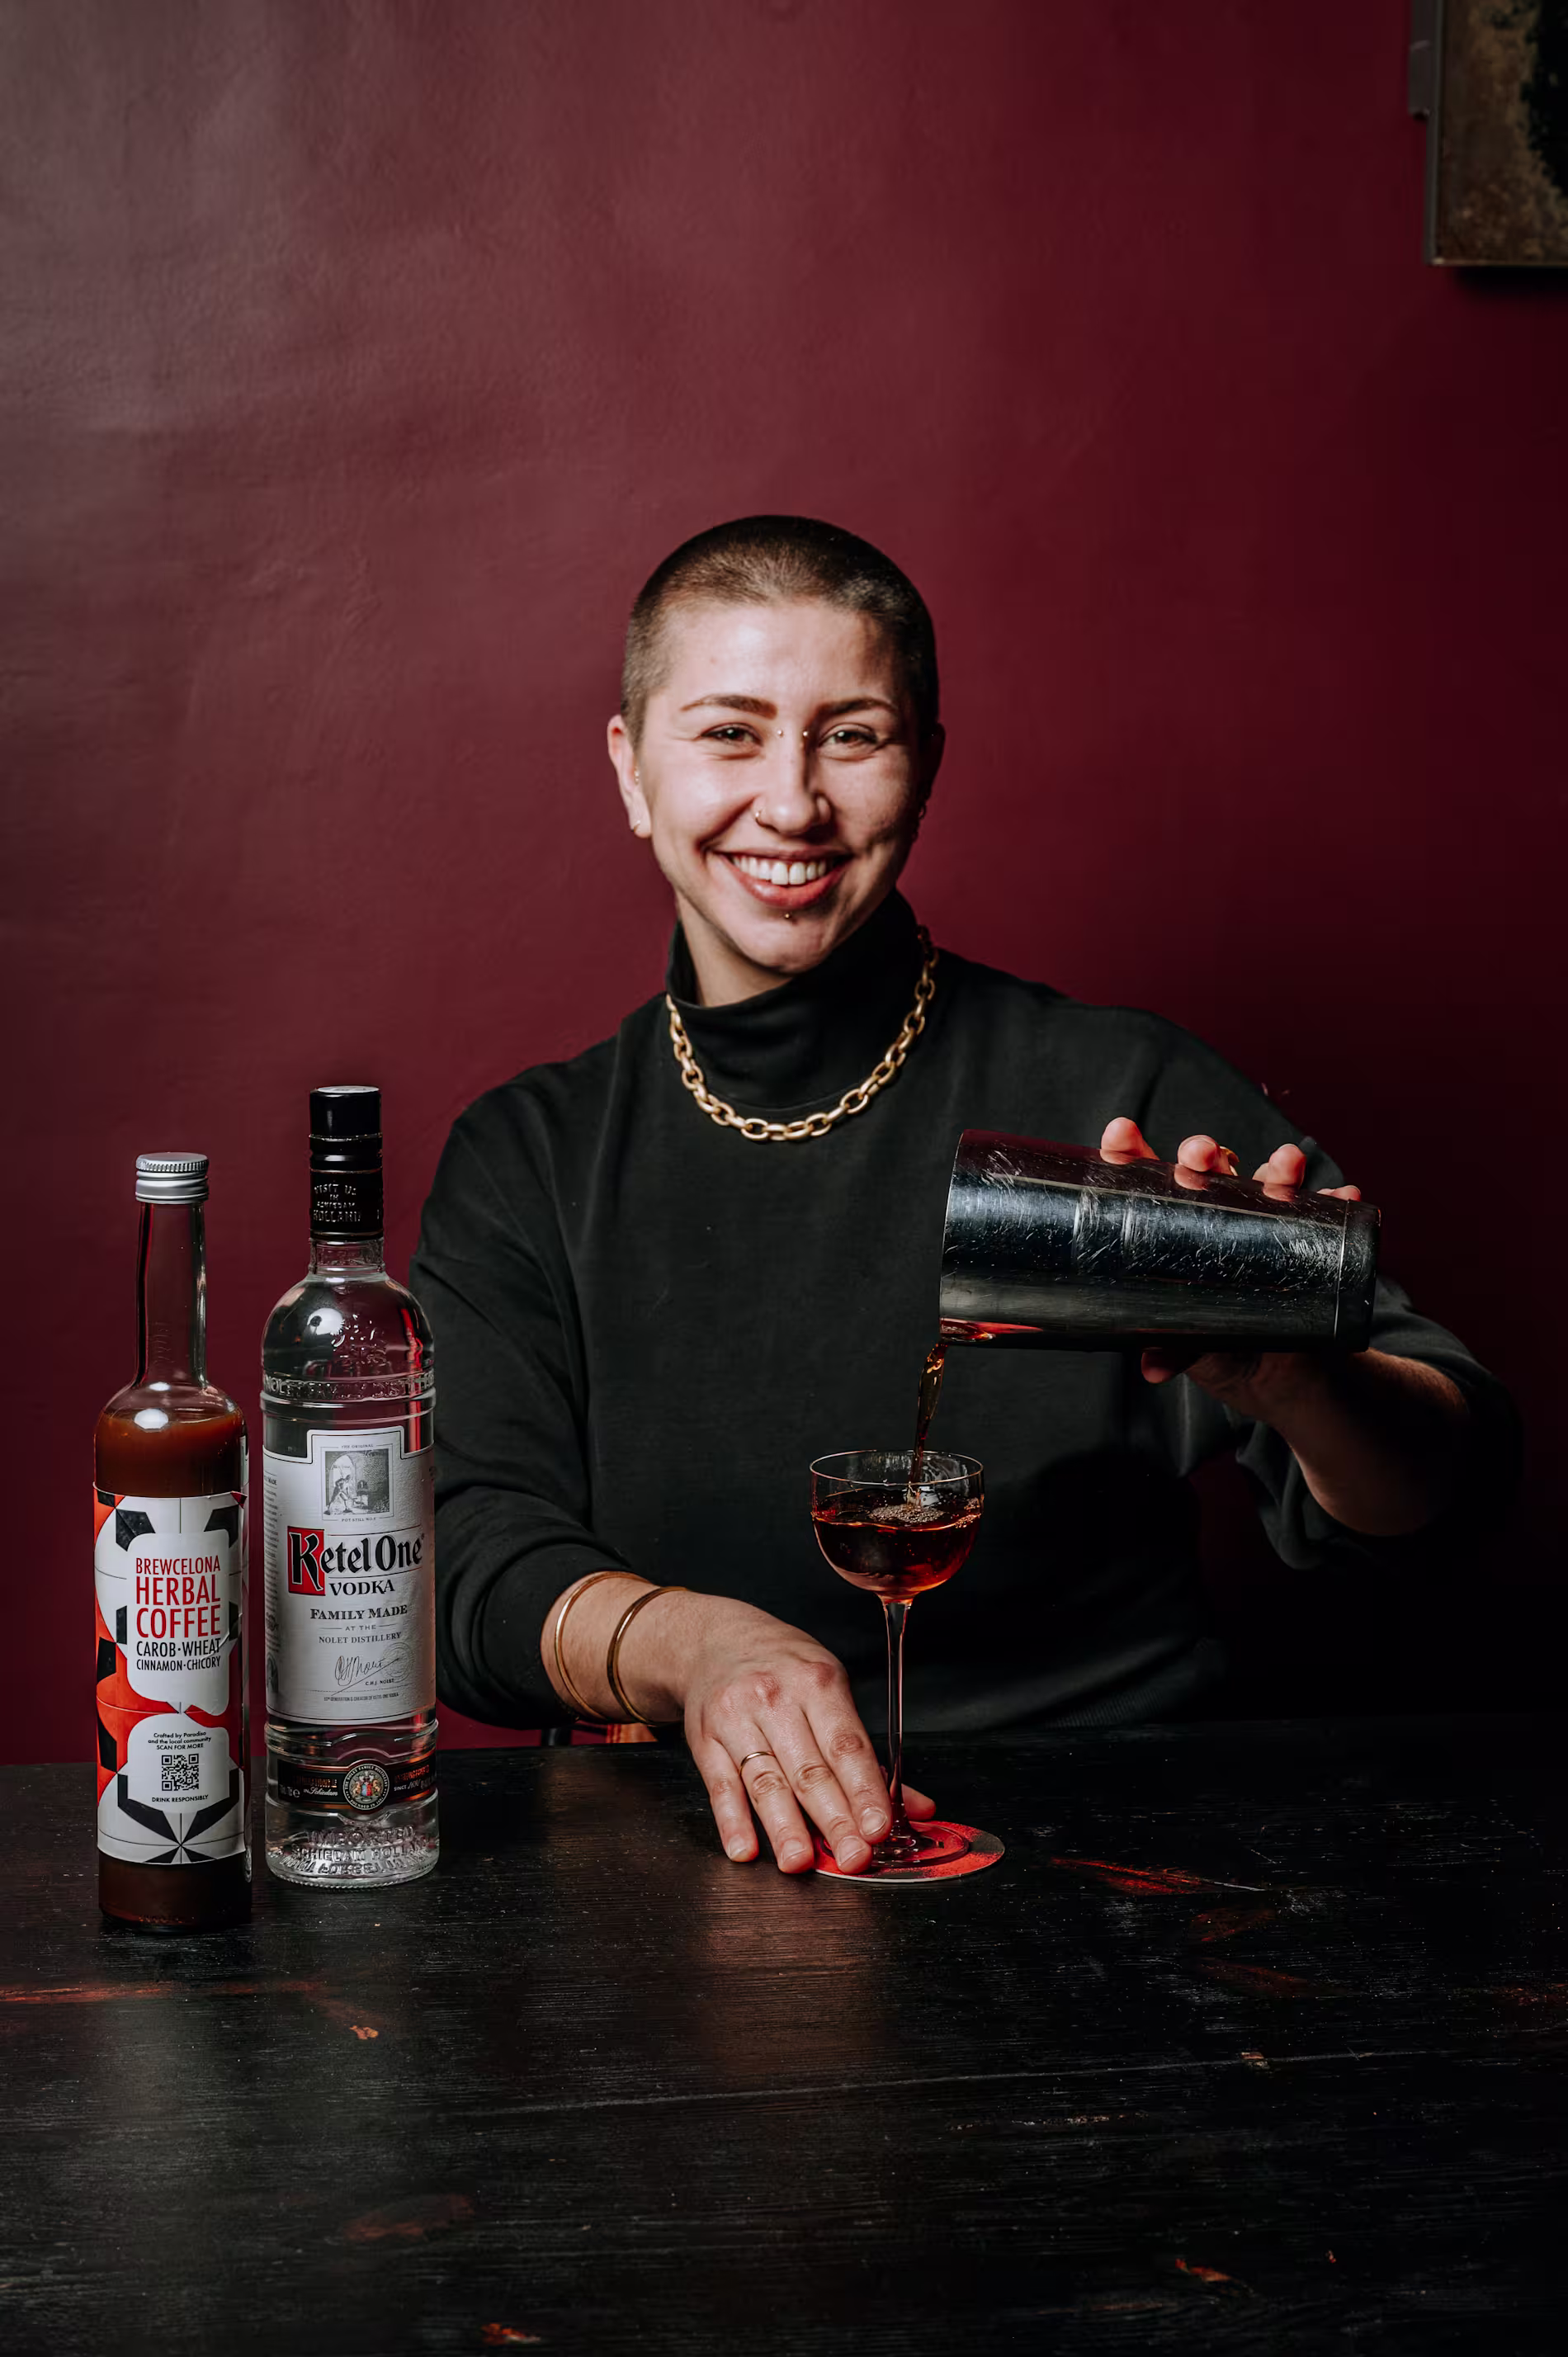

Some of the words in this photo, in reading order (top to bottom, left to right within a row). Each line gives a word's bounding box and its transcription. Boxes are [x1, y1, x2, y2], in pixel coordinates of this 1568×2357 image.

[136, 1555, 221, 1575] BREWCELONA
[289, 1533, 371, 1591] Ketel
[136, 1574, 221, 1606] HERBAL
[329, 1579, 395, 1596] VODKA
[310, 1608, 366, 1620] FAMILY
[368, 1604, 408, 1618] MADE
[137, 1604, 221, 1639] COFFEE
[351, 1632, 401, 1644] DISTILLERY
[172, 1794, 209, 1802] RESPONSIBLY
